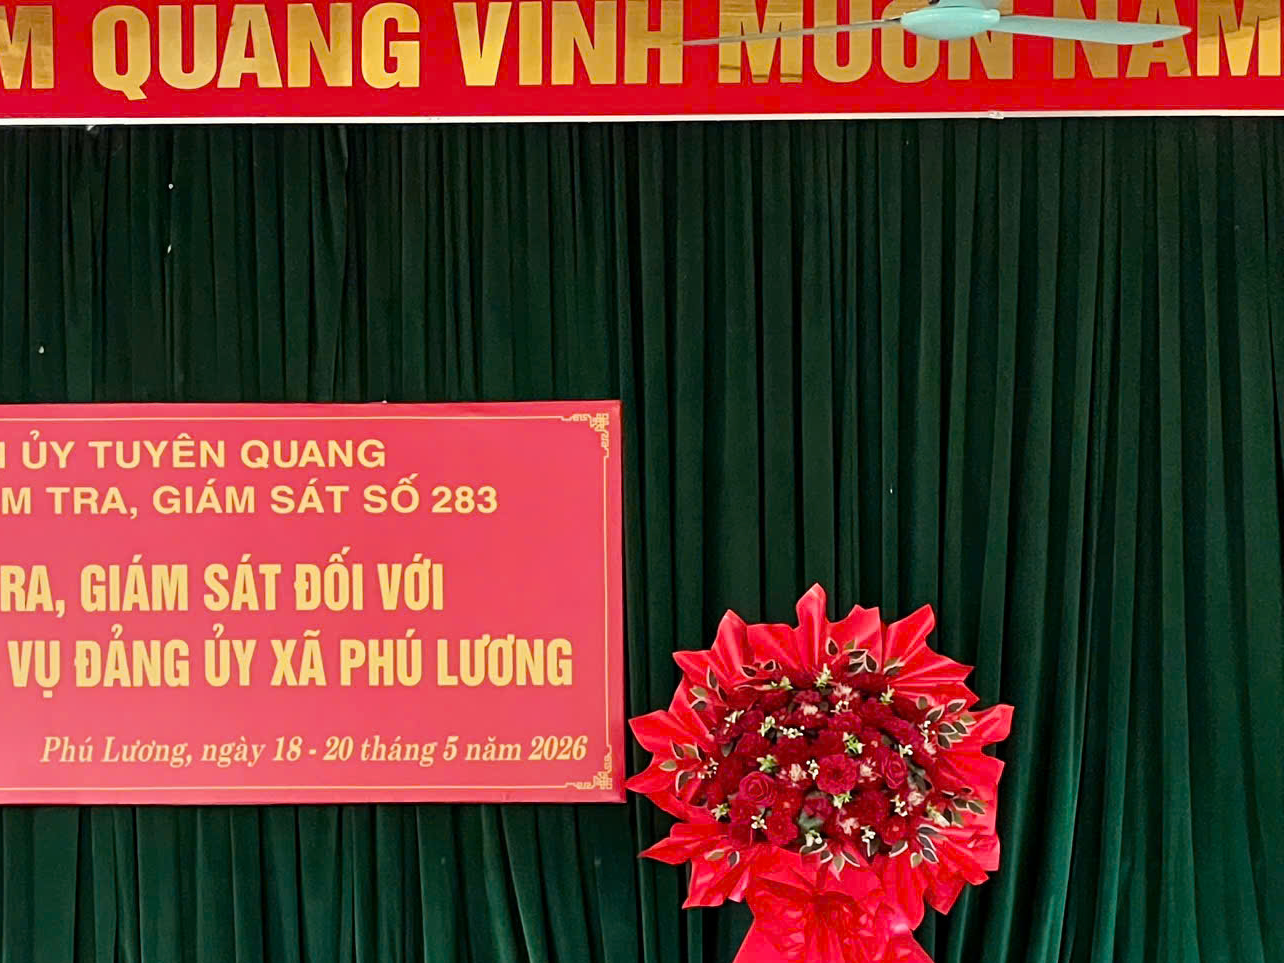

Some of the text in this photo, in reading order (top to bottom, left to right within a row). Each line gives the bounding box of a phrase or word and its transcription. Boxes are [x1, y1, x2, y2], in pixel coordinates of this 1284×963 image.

[92, 1, 421, 101] QUANG
[458, 0, 684, 86] VINH
[22, 430, 76, 469] ỦY
[88, 433, 225, 468] TUYÊN
[240, 439, 385, 468] QUANG
[45, 487, 138, 519] TRA,
[152, 478, 255, 514] GIÁM
[270, 477, 349, 514] SÁT
[363, 473, 420, 514] SỐ
[431, 486, 498, 513] 283
[80, 554, 189, 612] GIÁM
[203, 553, 282, 611] SÁT
[293, 546, 364, 611] ĐỐI
[377, 553, 444, 611] VỚI
[7, 639, 61, 698] VỤ
[73, 624, 190, 688] ĐẢNG
[204, 623, 257, 687] ỦY
[270, 630, 327, 687] XÃ
[340, 629, 422, 687] PHÚ
[437, 634, 573, 687] LƯƠNG
[39, 735, 94, 763] Phú
[101, 736, 193, 769] Lương,
[200, 735, 266, 768] ngày
[272, 735, 303, 761] 18
[322, 735, 354, 761] 20
[360, 735, 438, 767] tháng
[442, 735, 459, 761] 5
[464, 736, 522, 761] năm
[528, 735, 589, 761] 2026
